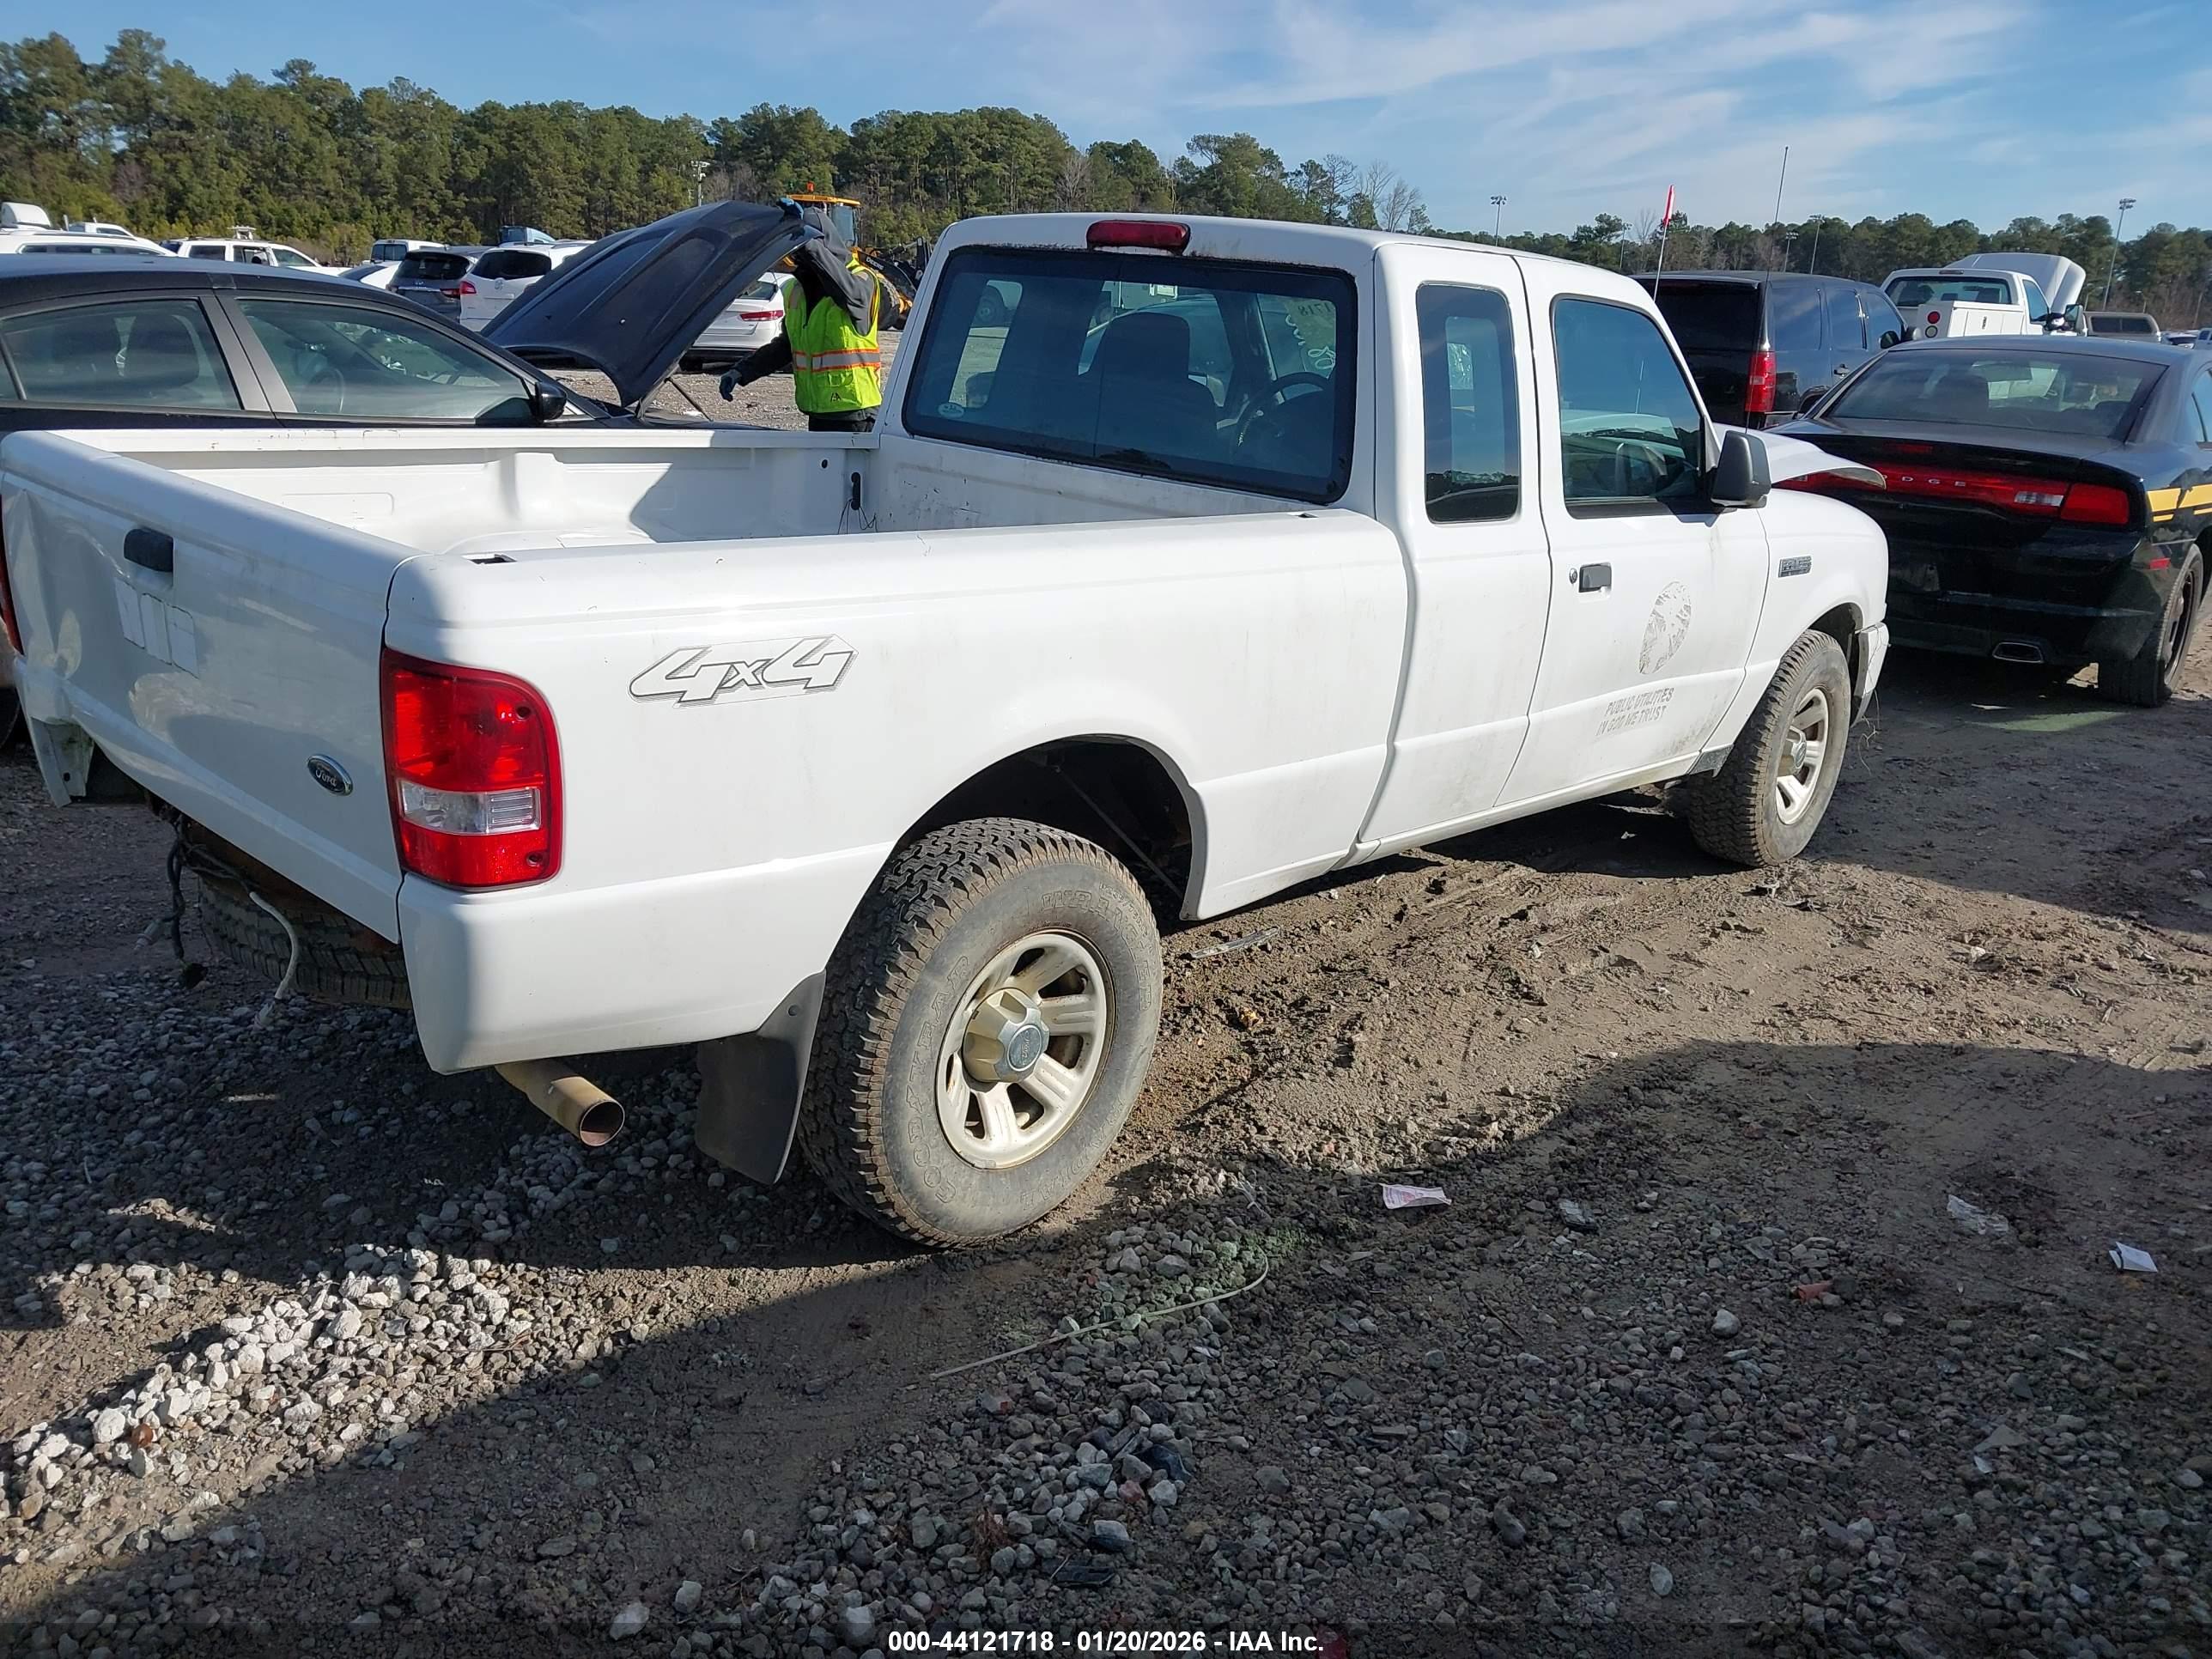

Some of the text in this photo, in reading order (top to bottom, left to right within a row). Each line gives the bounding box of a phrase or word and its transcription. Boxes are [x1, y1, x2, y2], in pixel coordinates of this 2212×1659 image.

[866, 256, 884, 270] DEERE
[629, 637, 856, 706] 4x4
[1638, 705, 1668, 724] TRUST
[906, 955, 968, 1203] GOODYEAR
